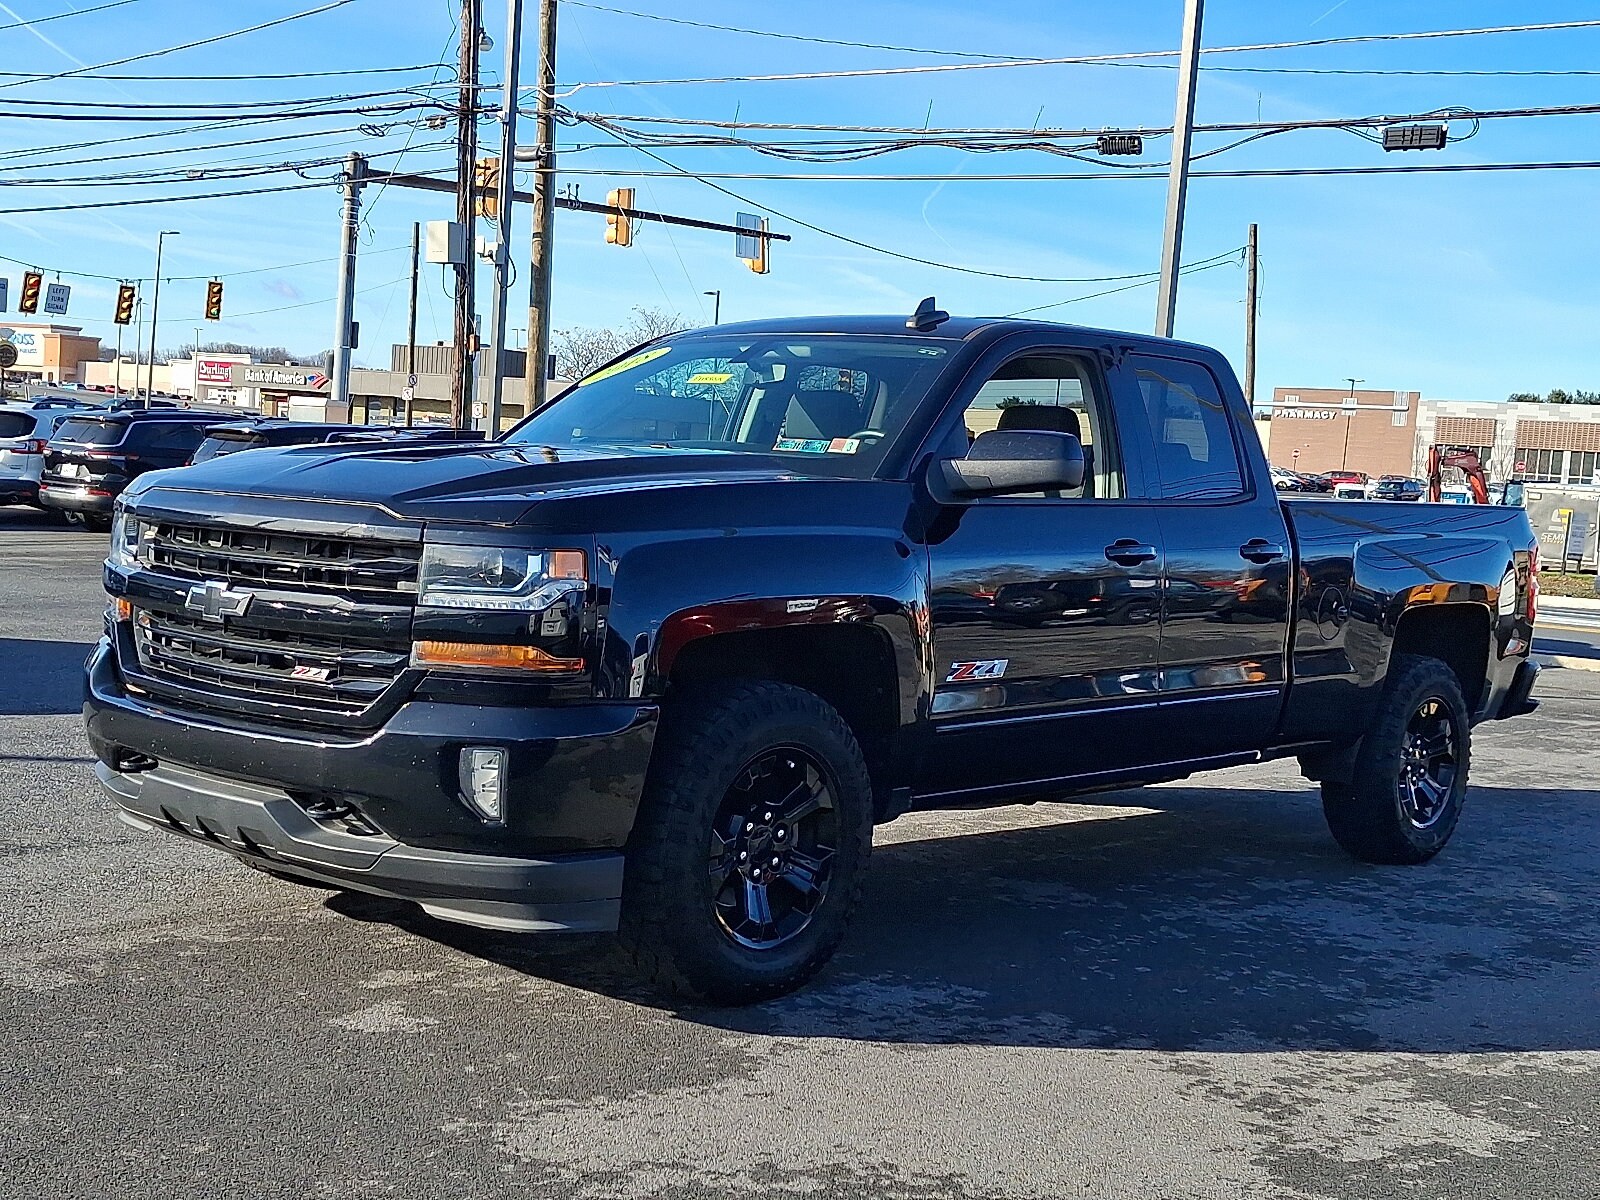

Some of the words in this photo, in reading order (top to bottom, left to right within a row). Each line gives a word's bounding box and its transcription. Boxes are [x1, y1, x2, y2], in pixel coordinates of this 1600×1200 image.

[53, 287, 65, 295] LEFT
[47, 303, 64, 311] SIGNAL
[245, 369, 265, 382] Bank
[264, 370, 275, 383] of
[273, 370, 307, 385] America
[1274, 408, 1337, 420] PHARMACY
[945, 658, 1009, 682] Z71
